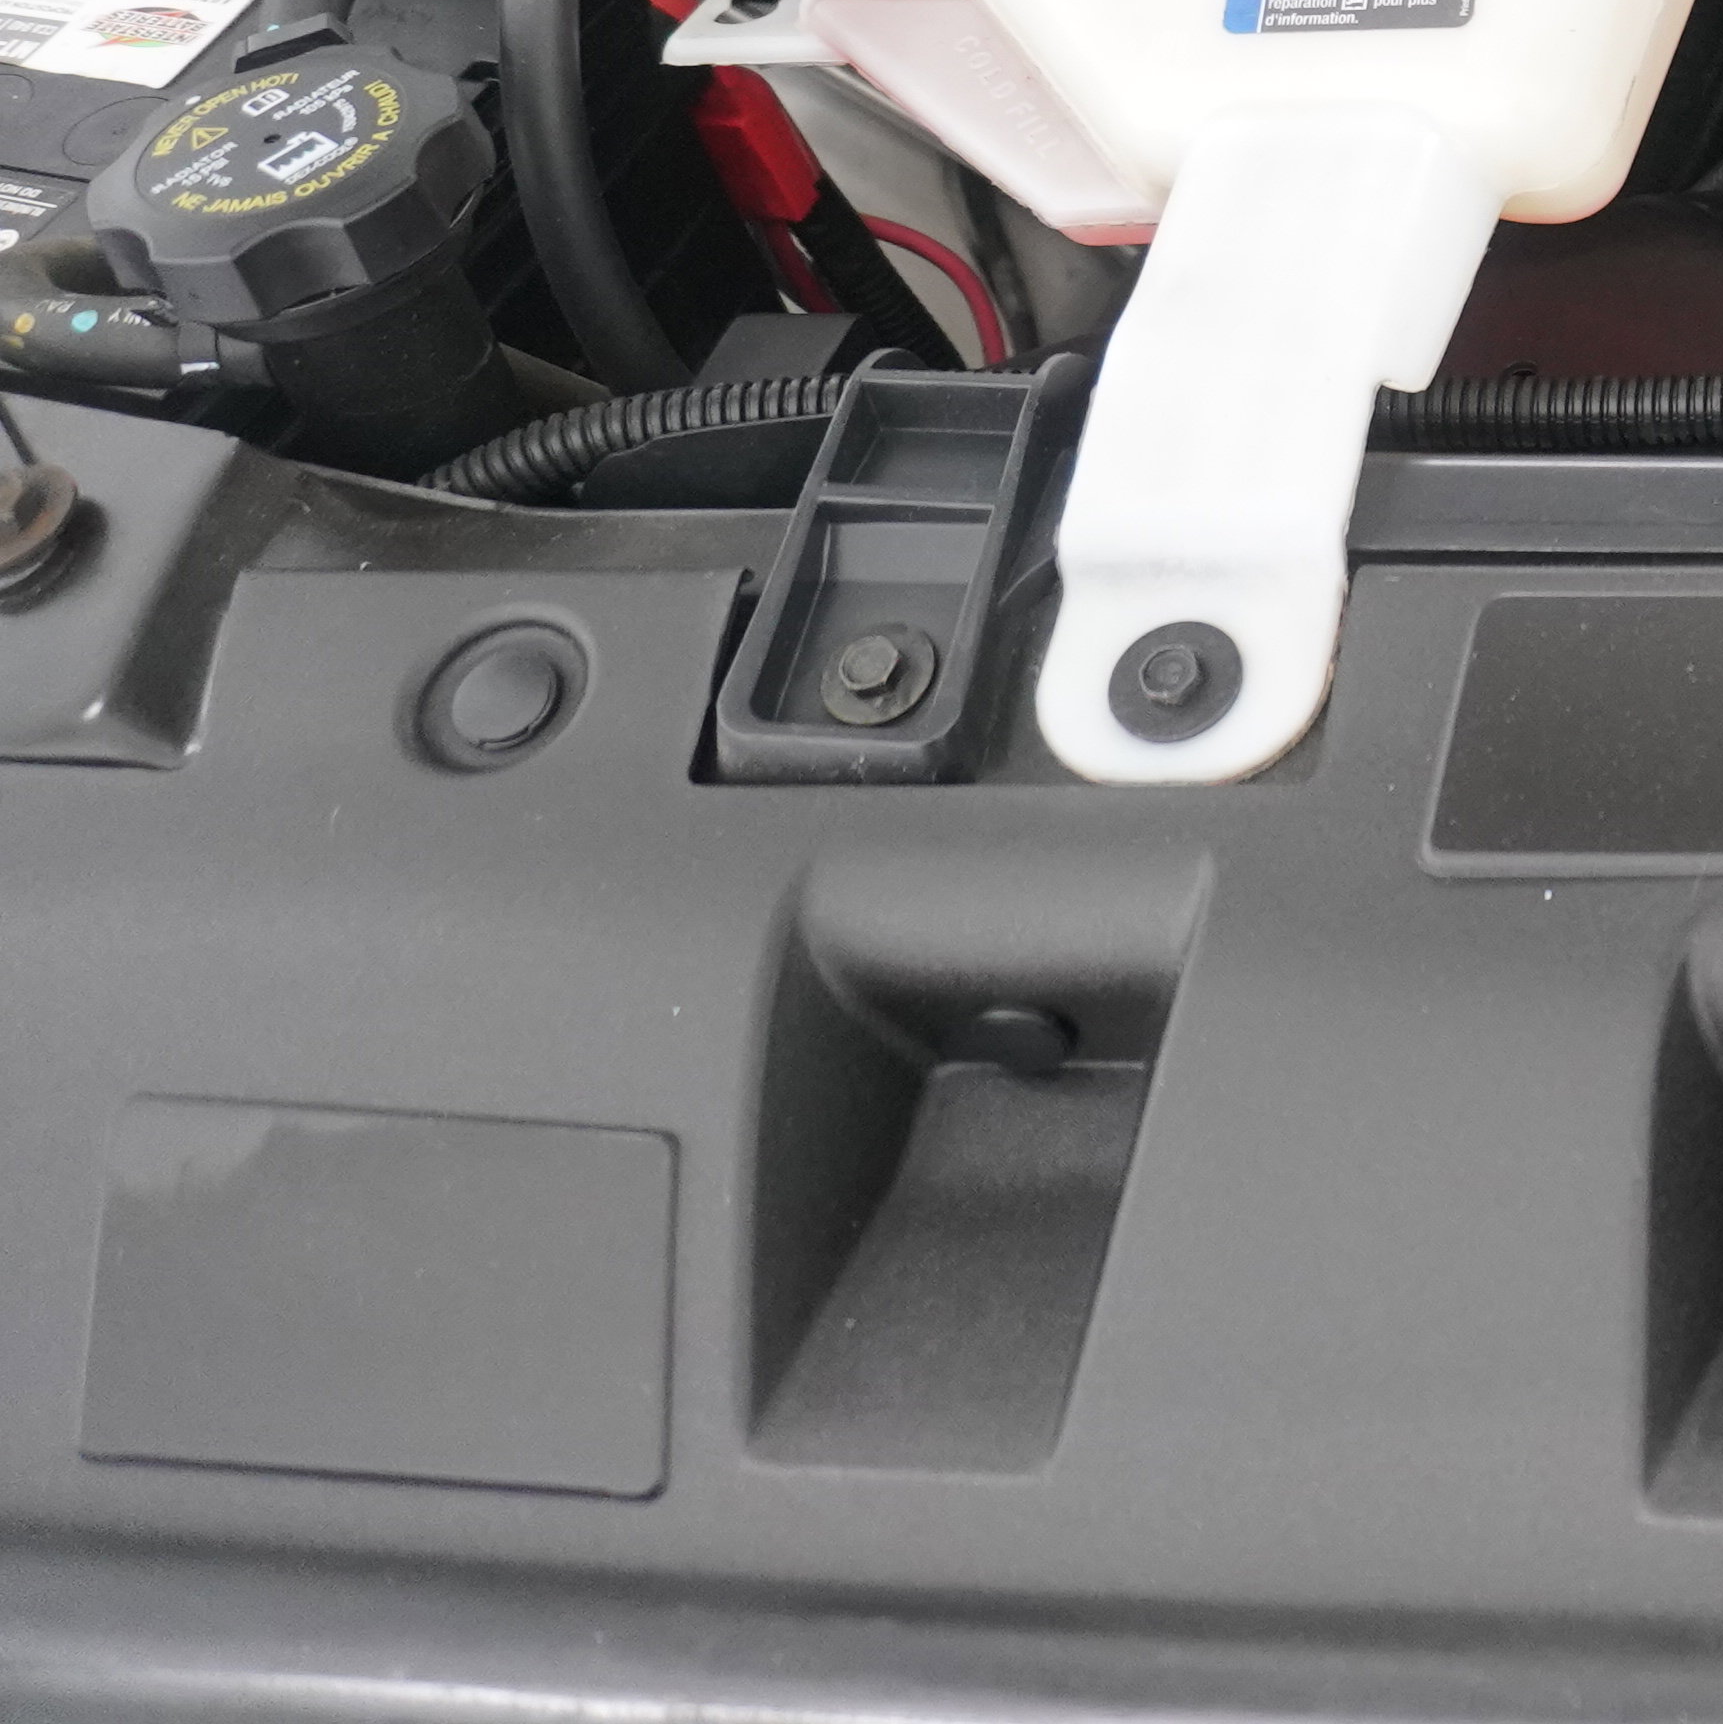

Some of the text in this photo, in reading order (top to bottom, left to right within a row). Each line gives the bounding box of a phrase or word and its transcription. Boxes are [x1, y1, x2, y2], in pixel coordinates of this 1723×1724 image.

[87, 20, 201, 45] INTERSTATE
[107, 10, 207, 32] BATTERIES
[1264, 11, 1359, 27] d'information.
[151, 114, 199, 158] NEVER
[193, 84, 249, 116] OPEN
[272, 69, 361, 121] RADIATEUR
[151, 140, 239, 195] RADIATOR
[171, 190, 208, 211] NE
[202, 190, 288, 214] JAMAIS
[293, 143, 381, 198] OUVRIR
